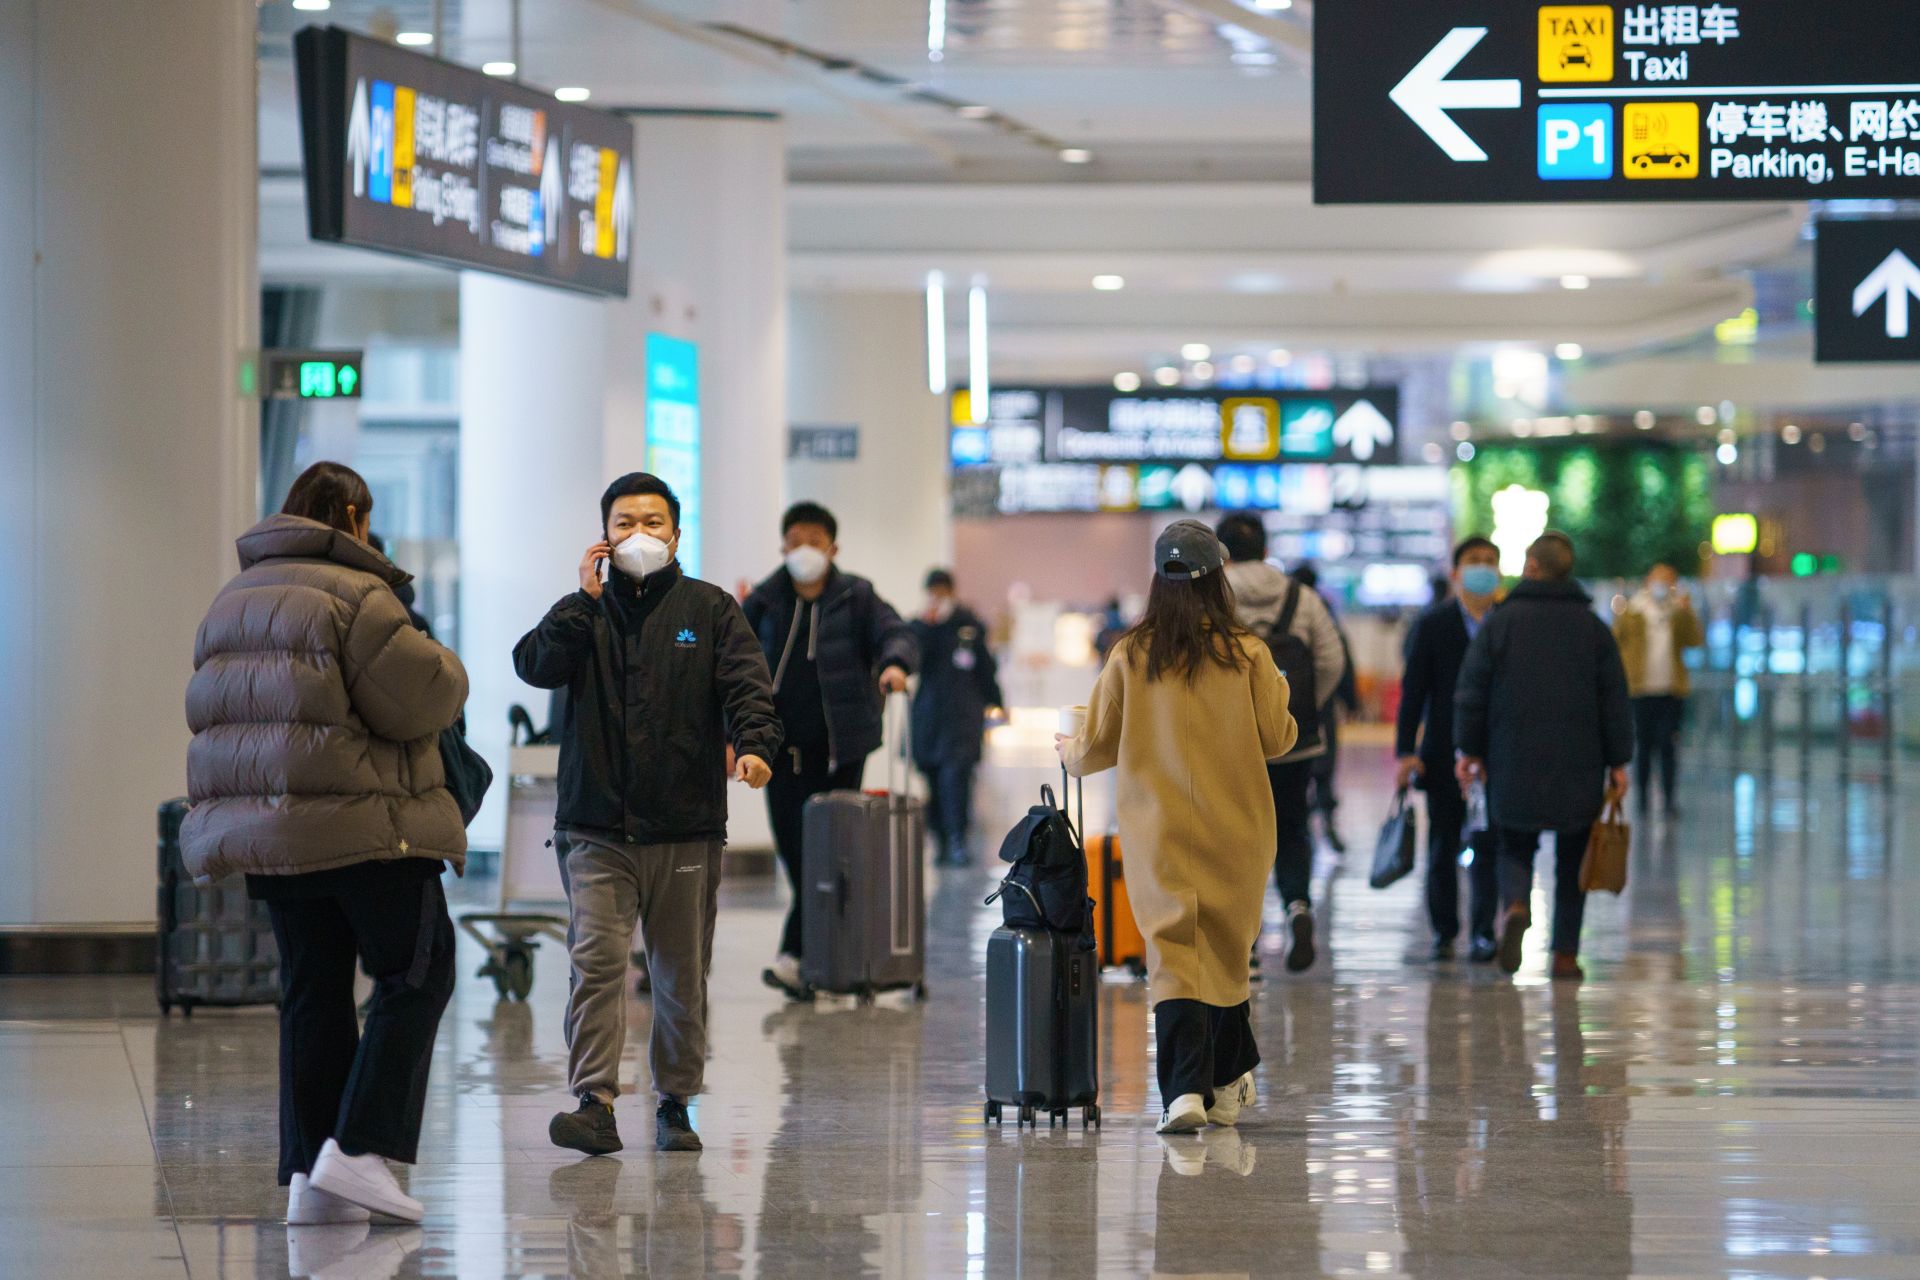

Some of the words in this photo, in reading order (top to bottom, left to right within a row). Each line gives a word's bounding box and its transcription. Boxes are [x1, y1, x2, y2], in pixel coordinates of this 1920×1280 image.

[1547, 17, 1605, 36] TAXI
[1622, 3, 1740, 46] 出租车
[1622, 50, 1688, 81] Taxi
[1545, 118, 1605, 165] P1
[1710, 147, 1834, 184] Parking,
